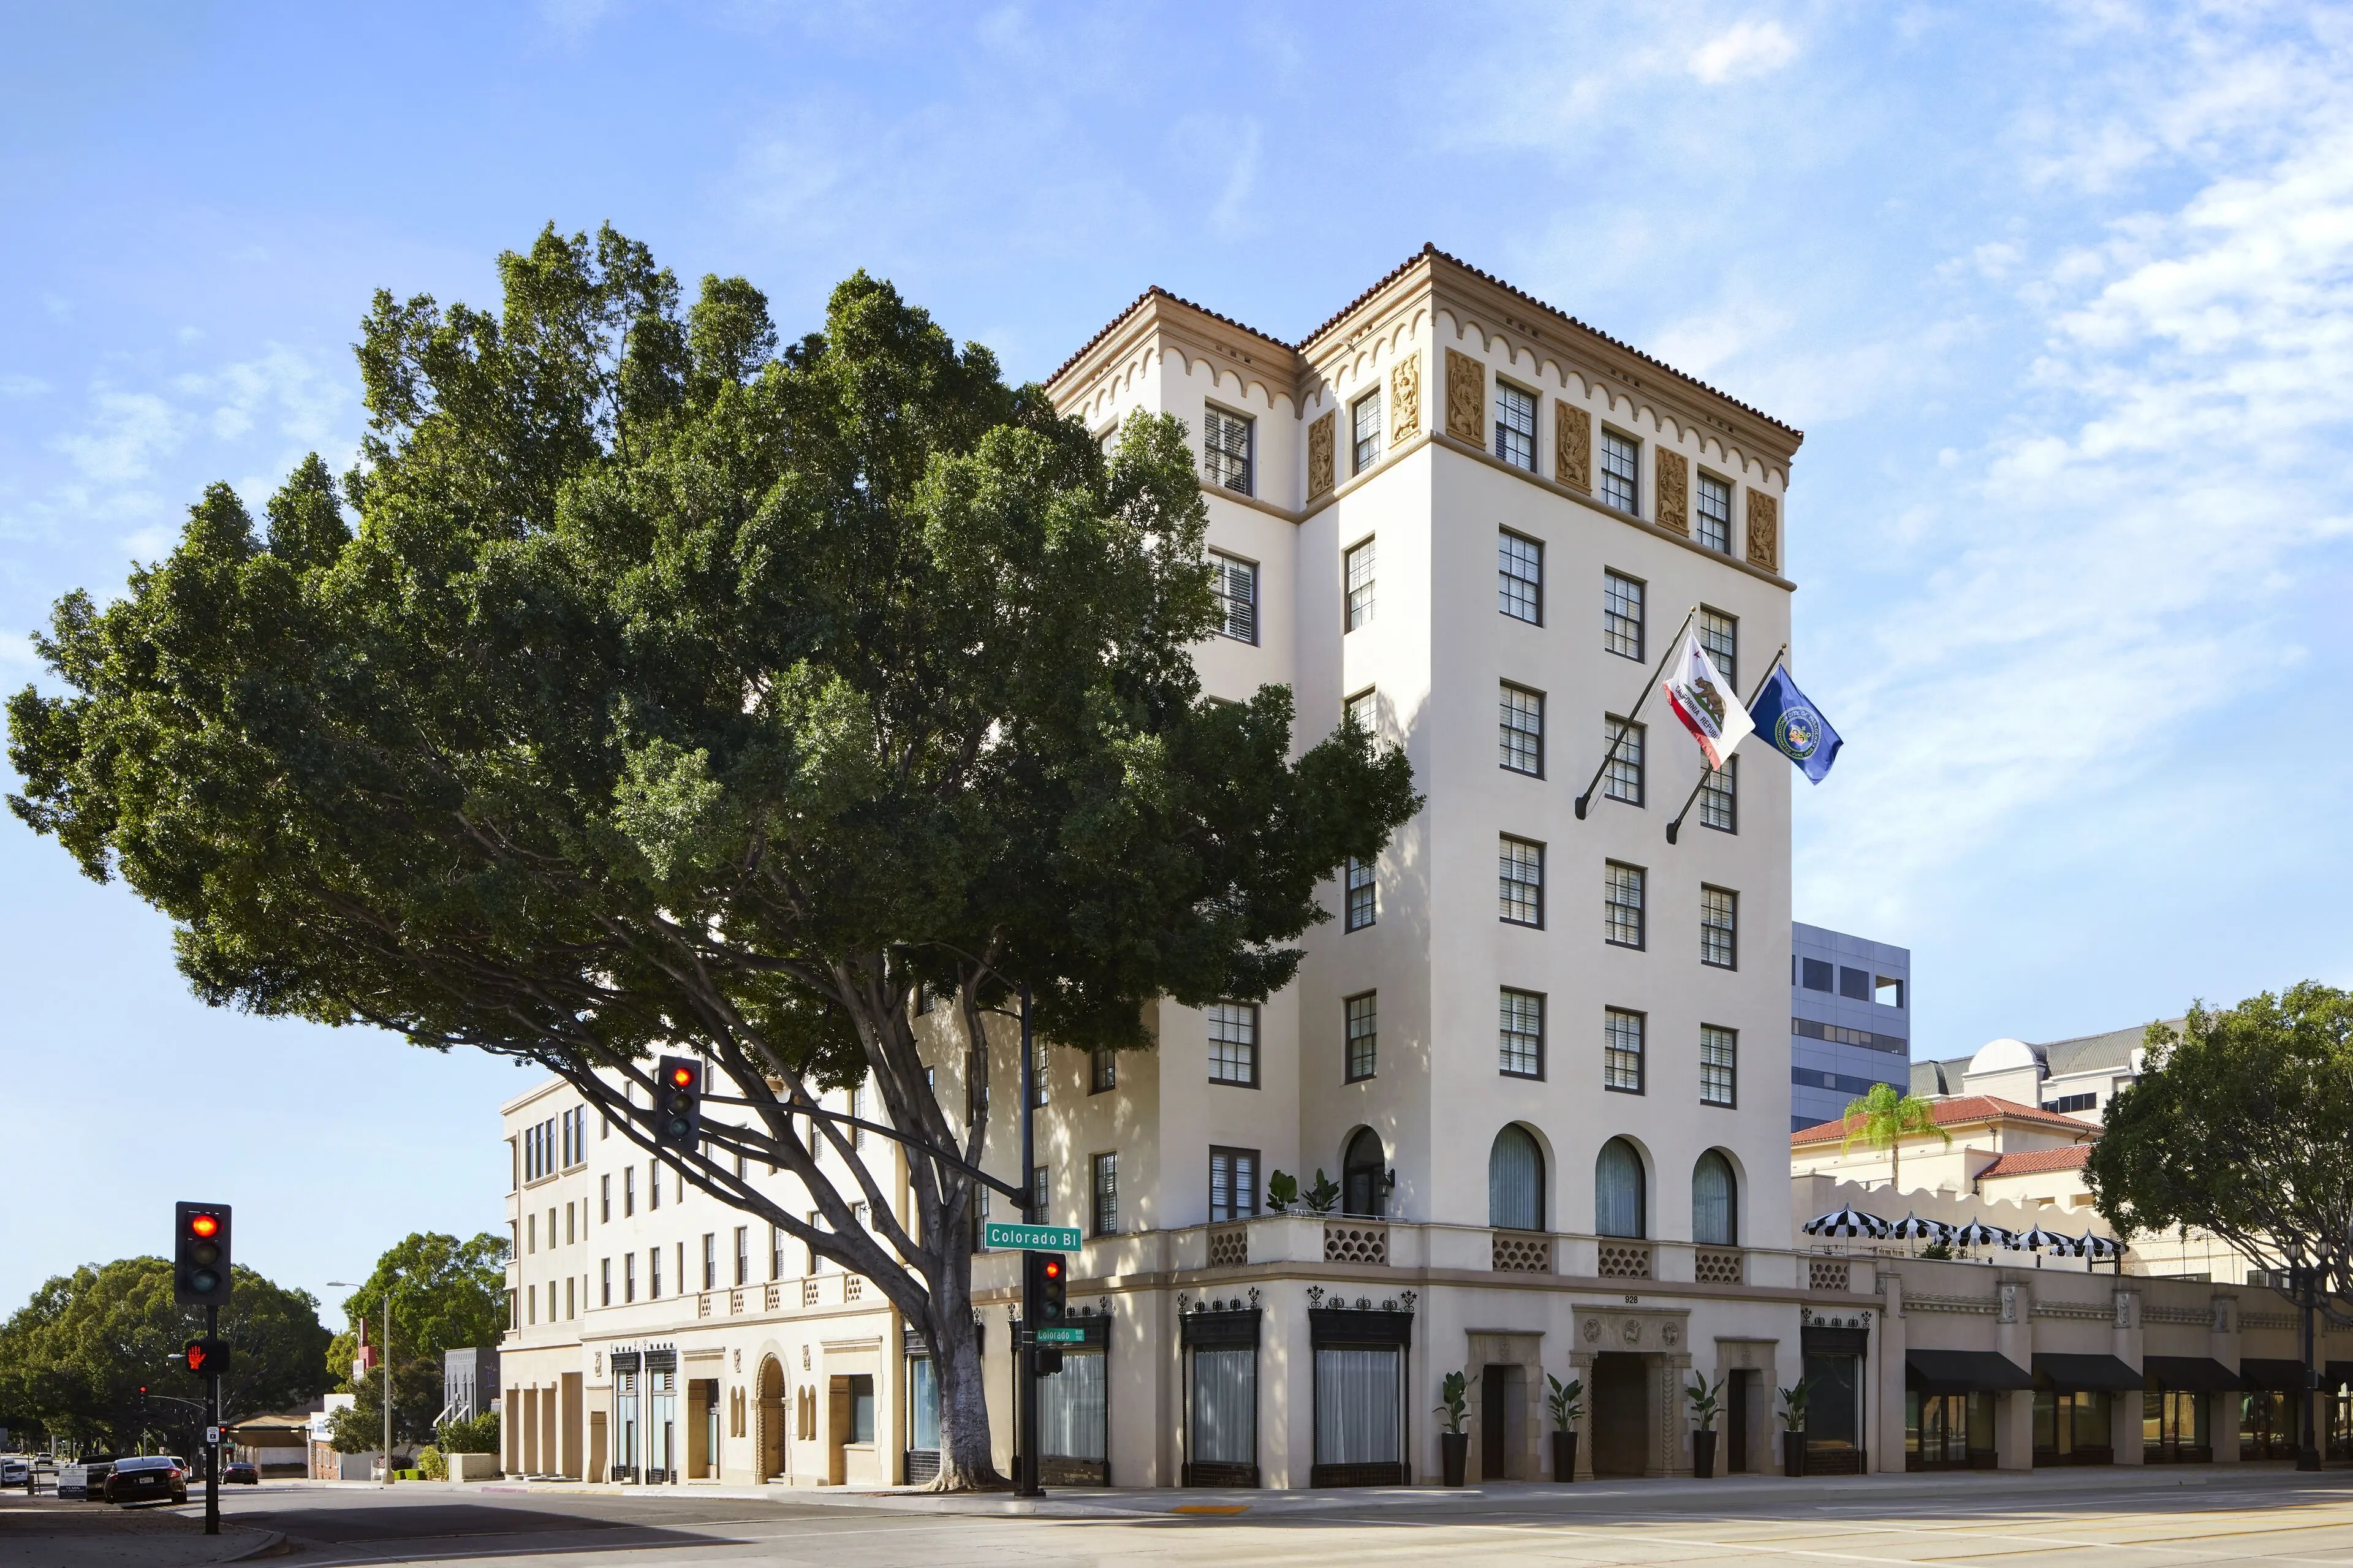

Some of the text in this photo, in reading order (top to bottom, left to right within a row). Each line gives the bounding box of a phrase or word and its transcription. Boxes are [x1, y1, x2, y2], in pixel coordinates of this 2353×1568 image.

[1675, 685, 1721, 745] CALIFORNIA REPUBLIC
[1778, 718, 1791, 753] INCORPORATED
[1809, 715, 1819, 744] PASADENA
[991, 1229, 1076, 1246] Colorado Bl
[1625, 1295, 1638, 1304] 928
[1038, 1330, 1069, 1339] Colorado
